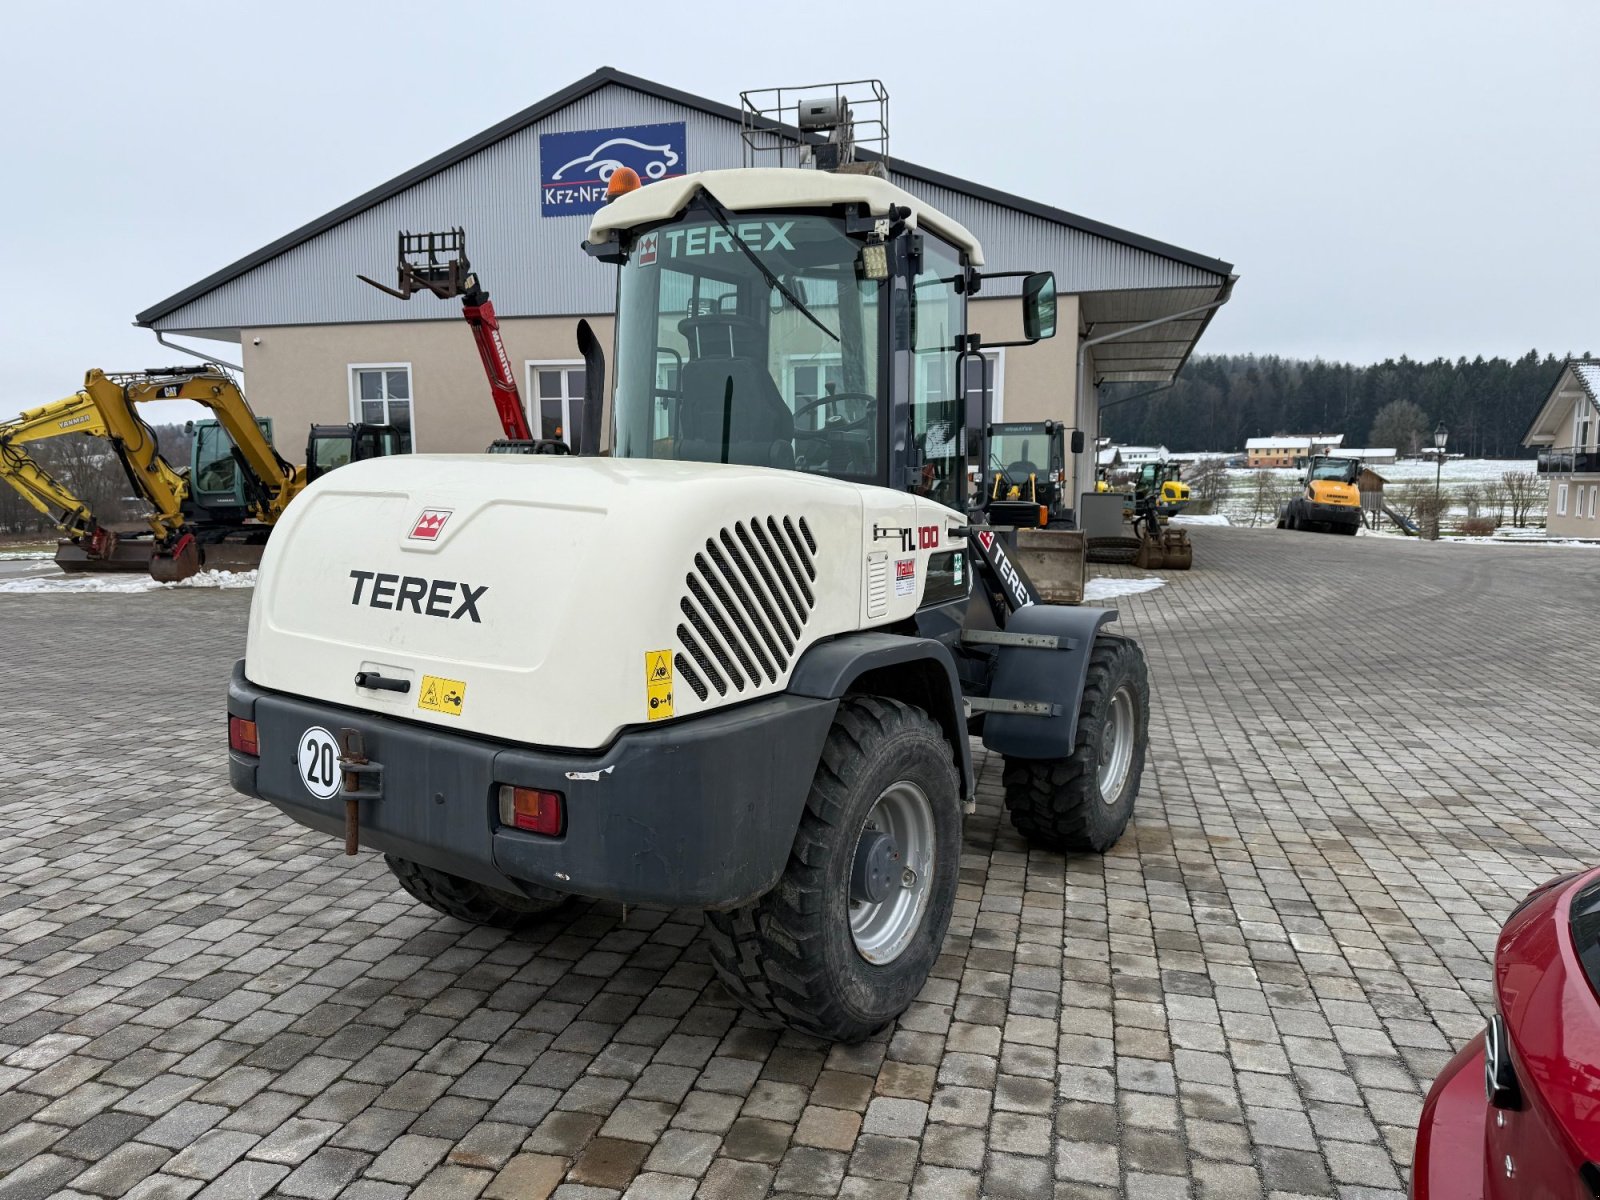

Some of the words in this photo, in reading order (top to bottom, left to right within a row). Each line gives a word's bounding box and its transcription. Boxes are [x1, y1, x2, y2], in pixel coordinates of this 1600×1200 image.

[666, 221, 796, 258] TEREX
[491, 330, 514, 384] MANITOU
[164, 386, 177, 398] CAT
[58, 415, 91, 429] YANMAR
[350, 569, 489, 624] TEREX
[306, 738, 334, 787] 20
